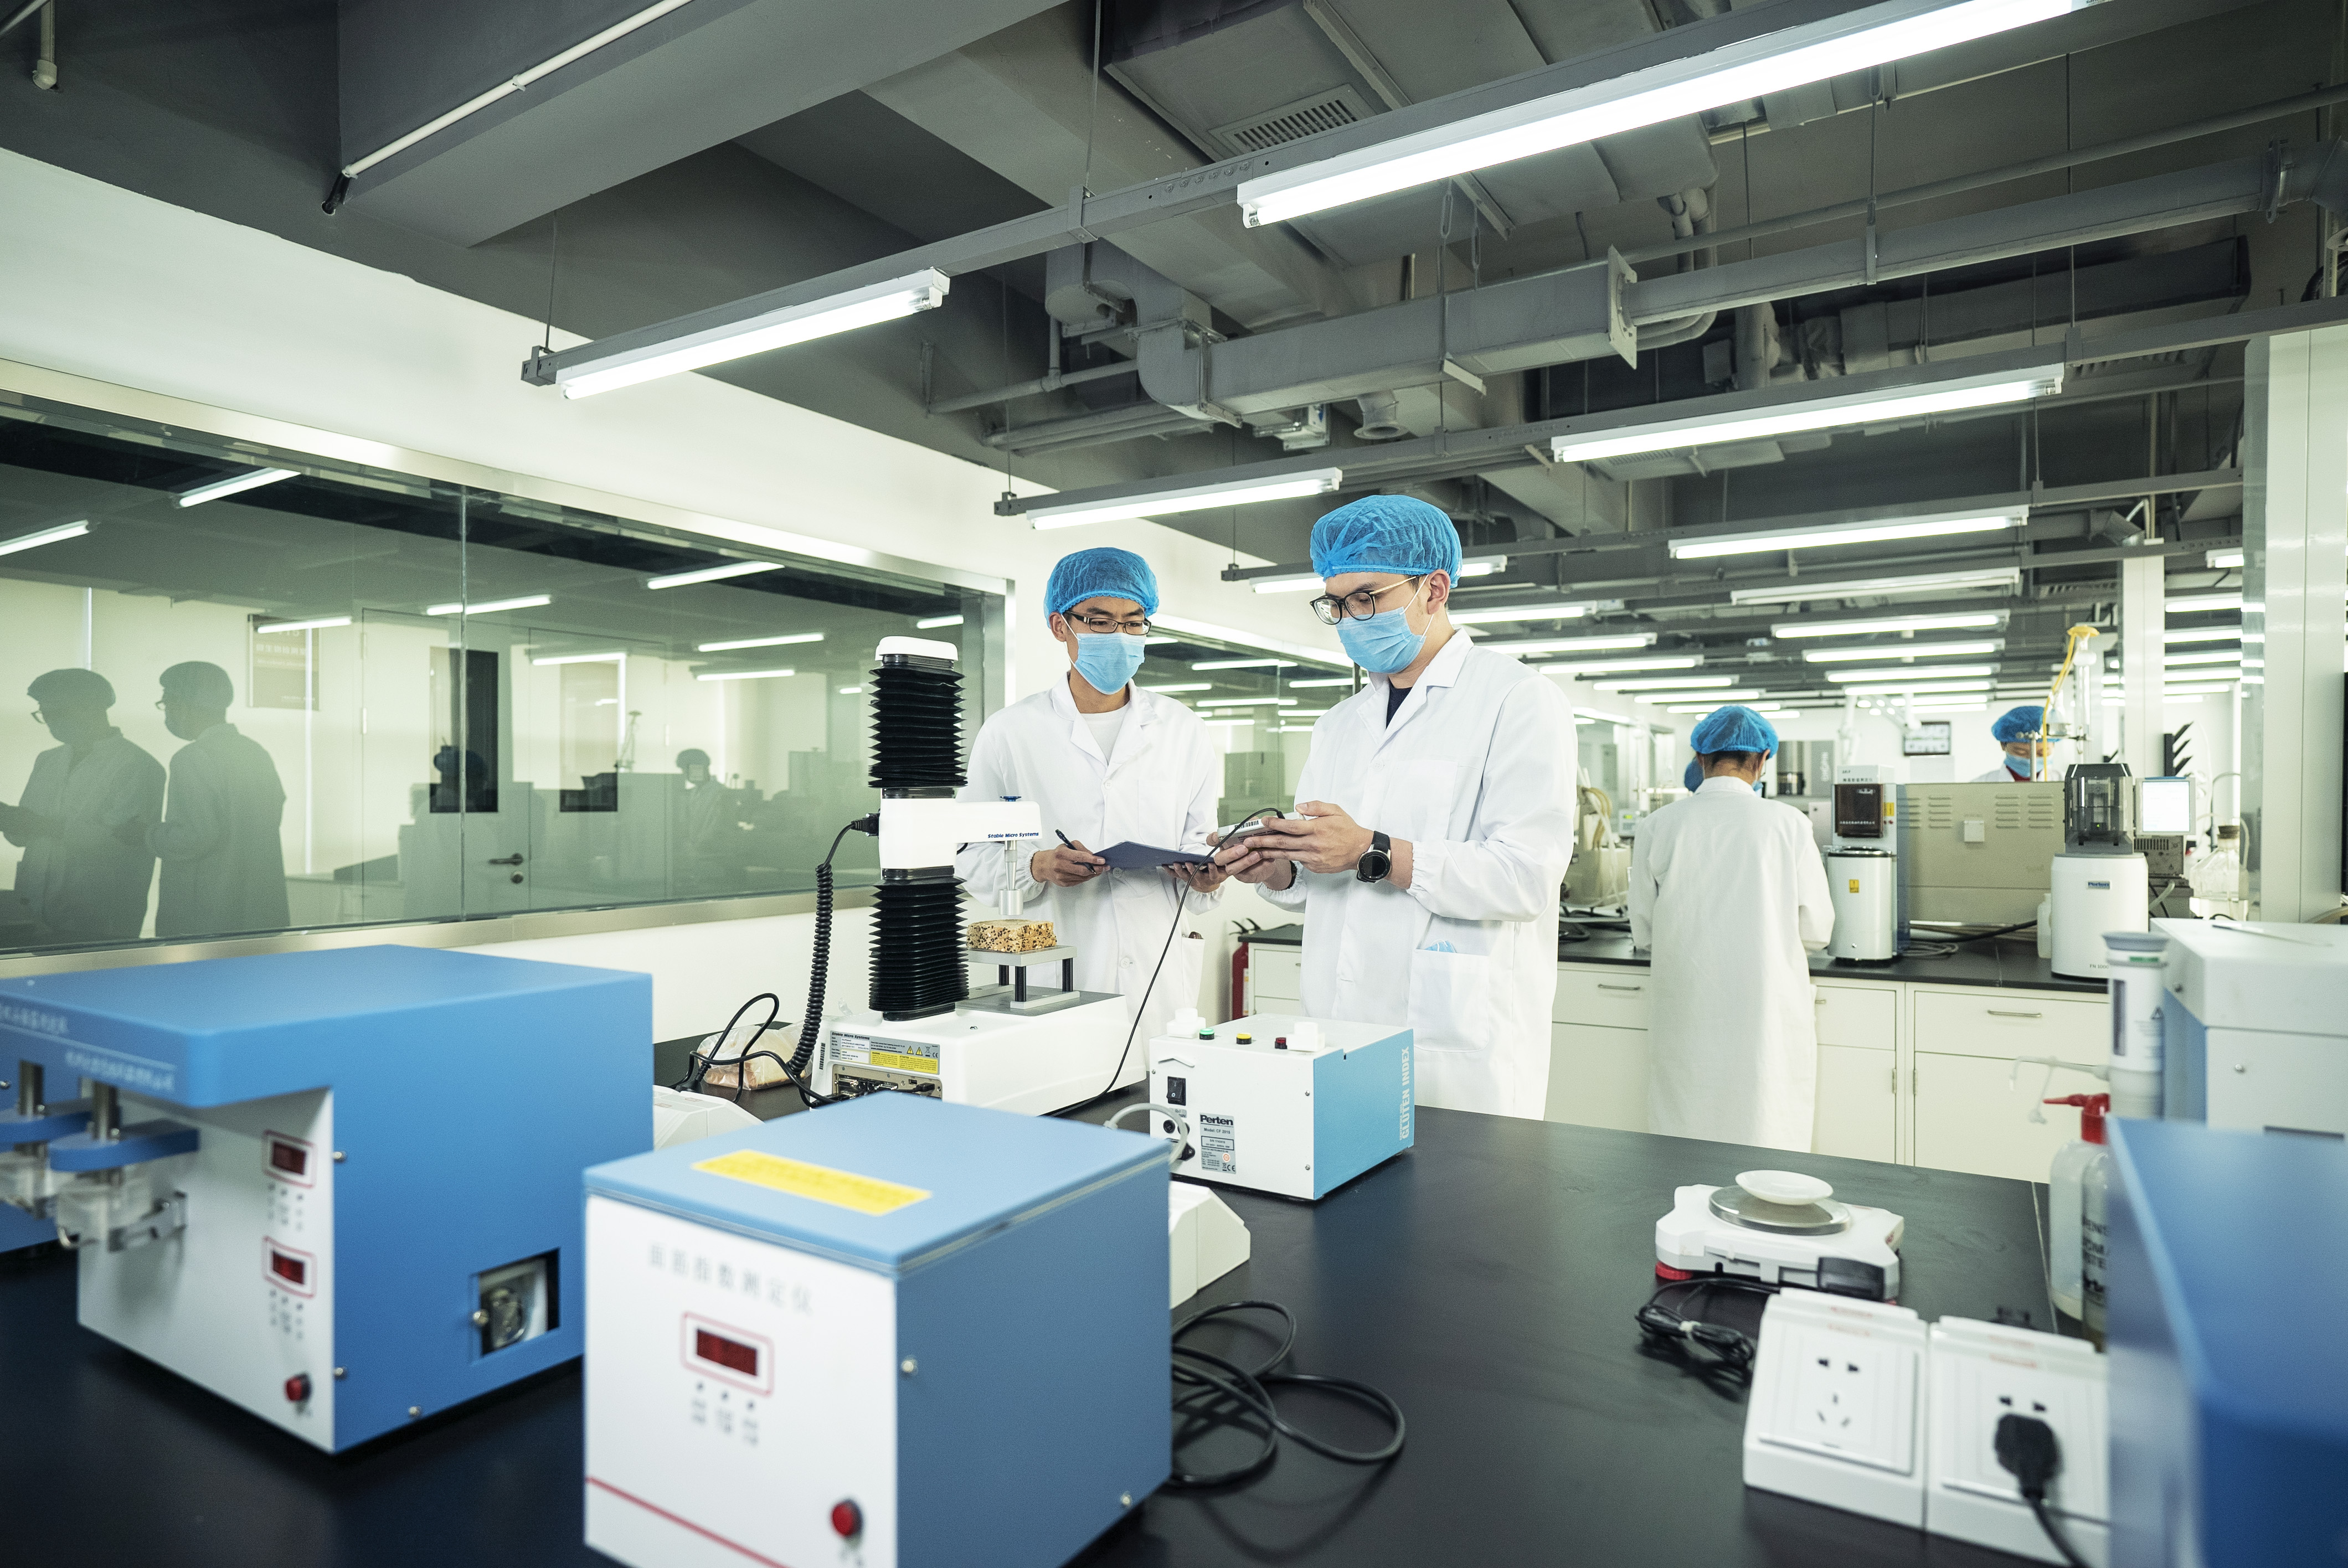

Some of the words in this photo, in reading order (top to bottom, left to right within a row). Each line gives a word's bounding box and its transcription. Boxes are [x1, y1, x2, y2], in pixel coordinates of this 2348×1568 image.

[1402, 1046, 1410, 1086] INDEX
[1201, 1115, 1233, 1126] Perten
[1402, 1089, 1410, 1139] GLUTEN
